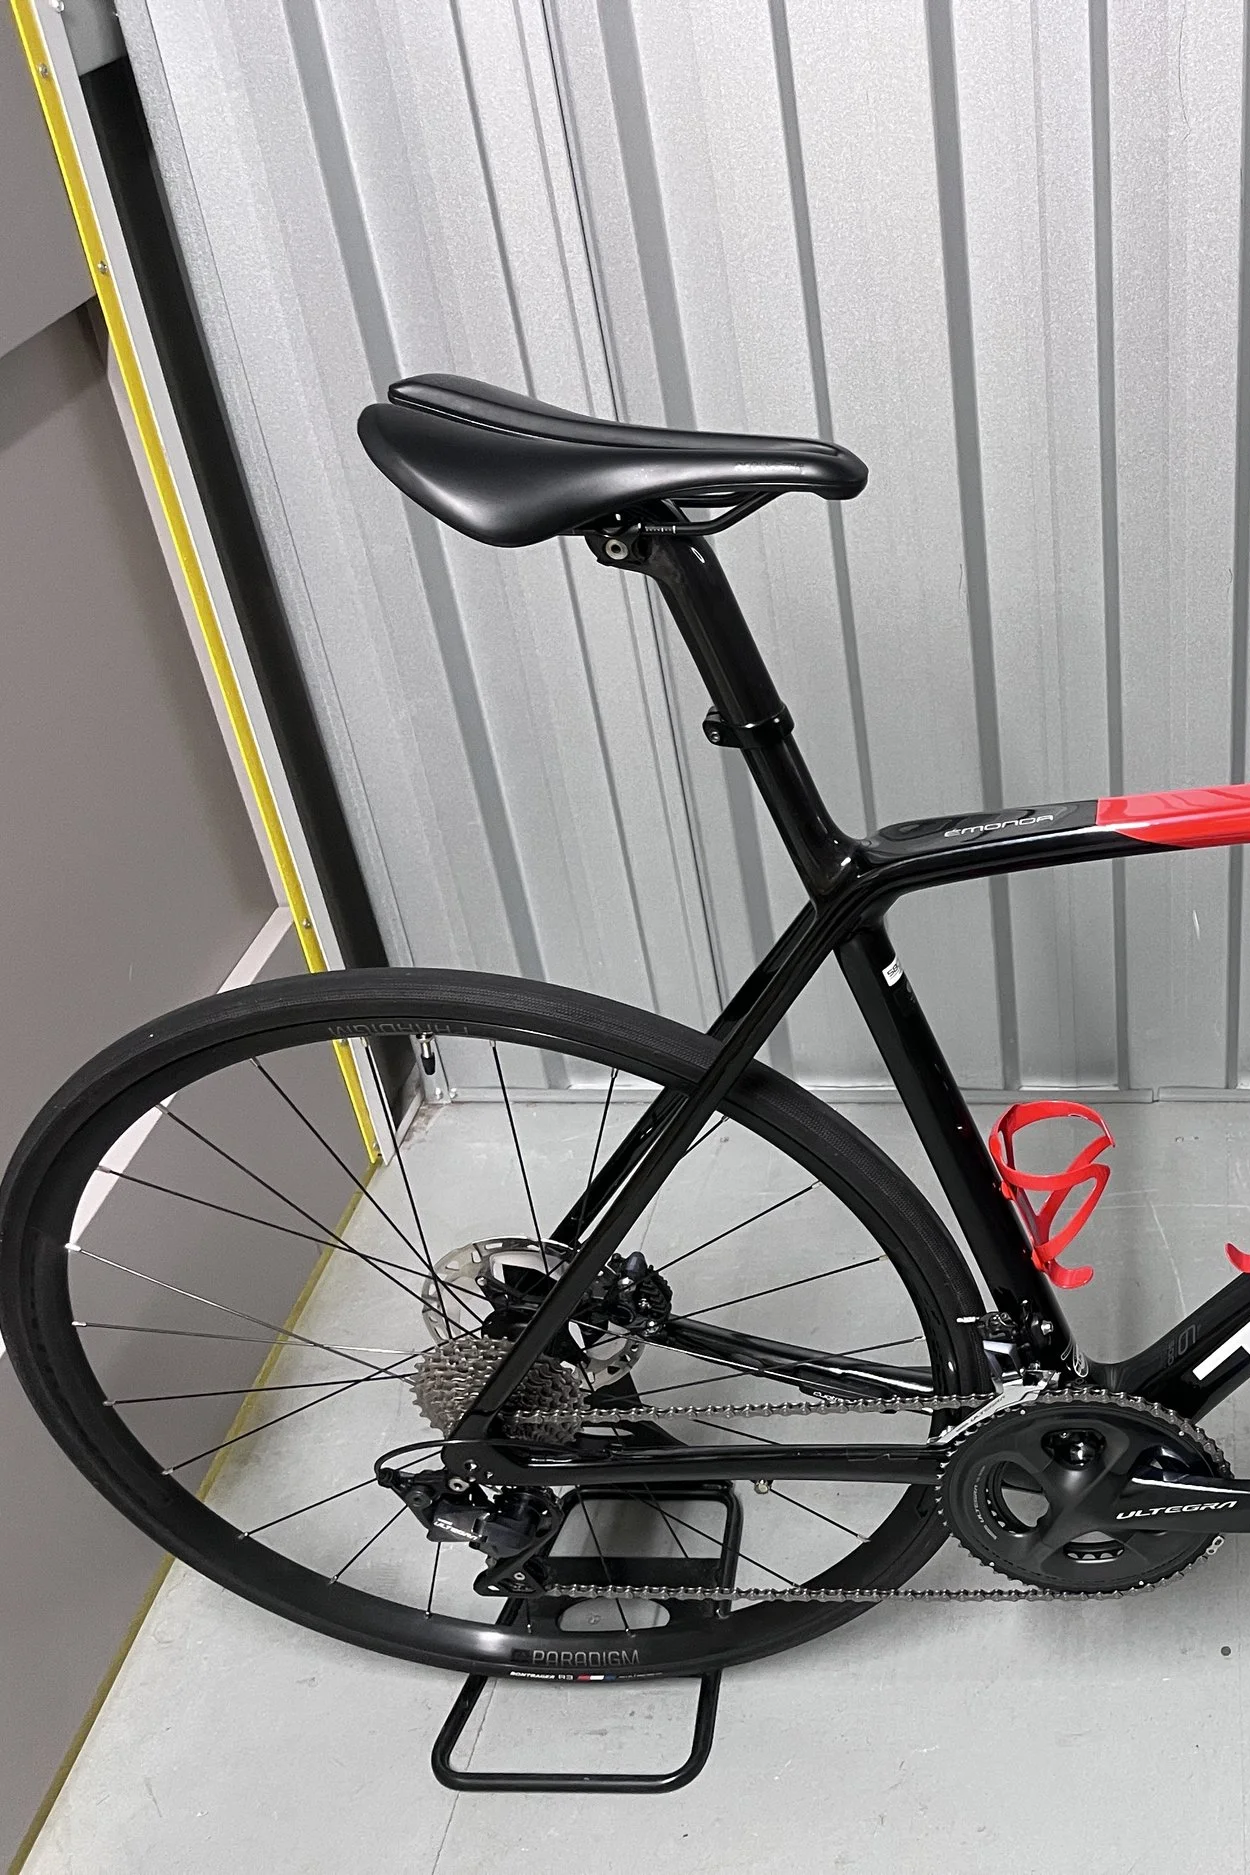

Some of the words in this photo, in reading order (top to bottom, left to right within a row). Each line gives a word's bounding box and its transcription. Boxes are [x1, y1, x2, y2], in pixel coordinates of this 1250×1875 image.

[1116, 1500, 1238, 1520] ULTEGRA
[531, 1649, 641, 1667] PARADIGM
[509, 1671, 556, 1680] BONTRAGER
